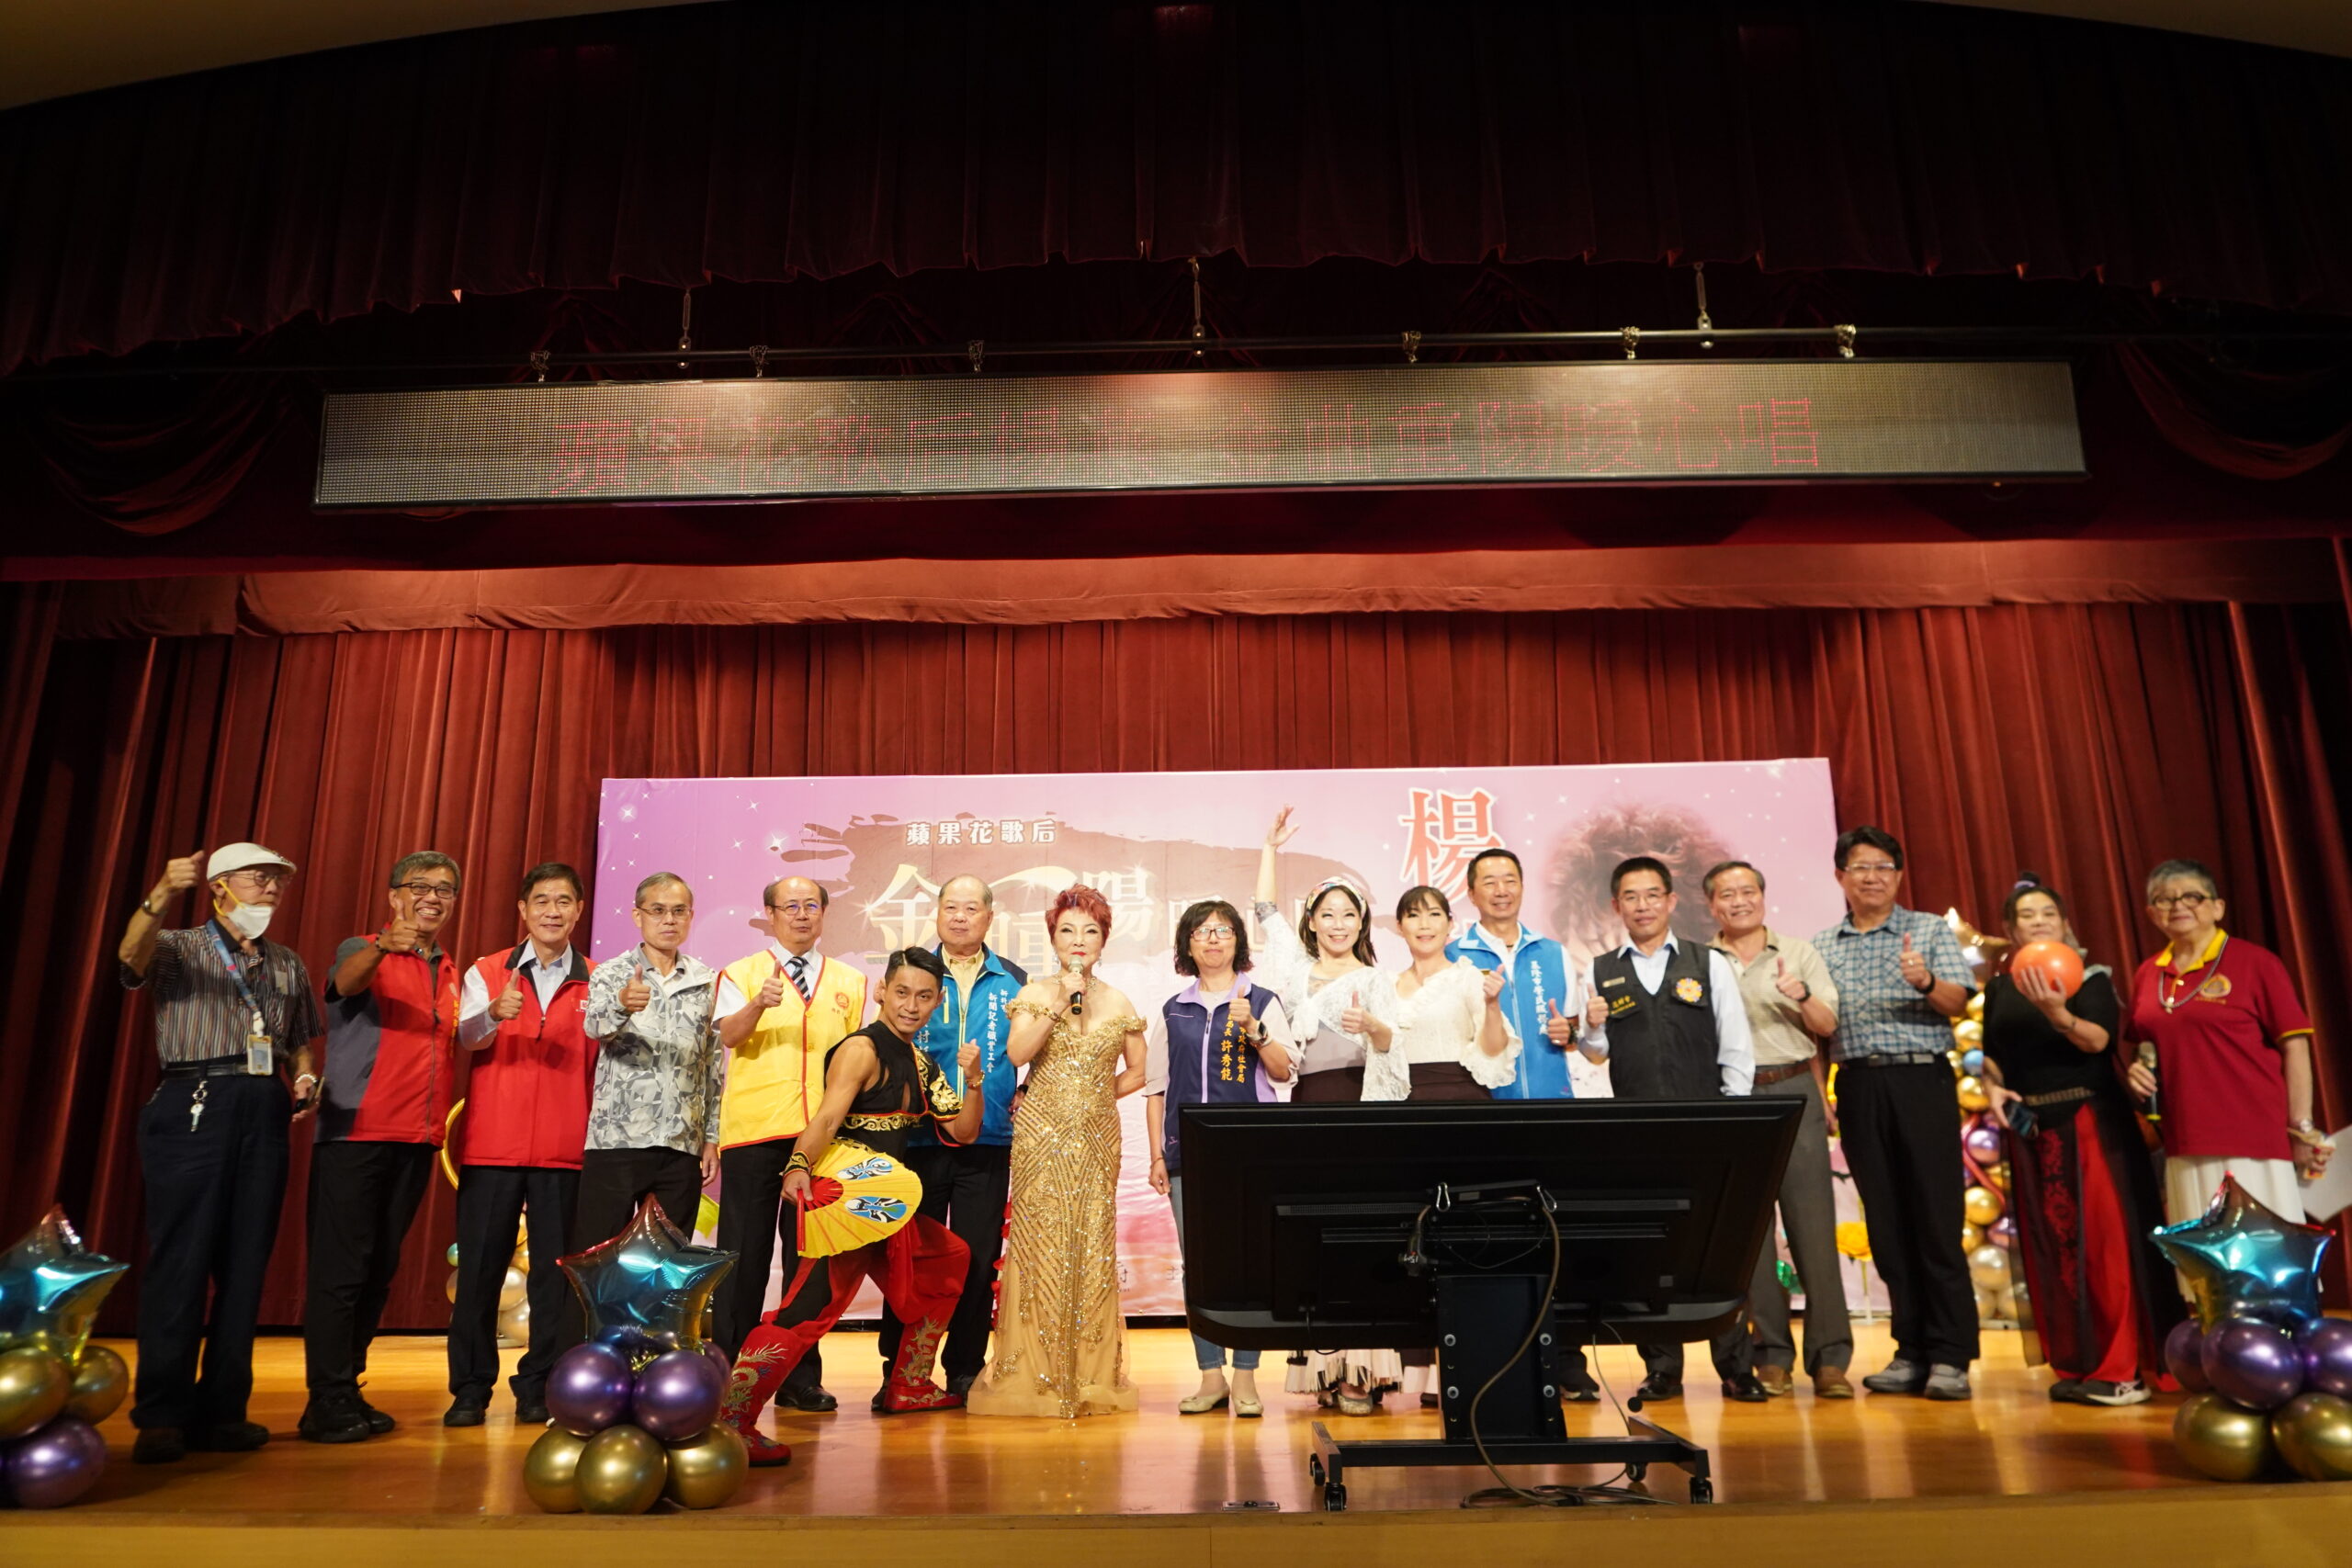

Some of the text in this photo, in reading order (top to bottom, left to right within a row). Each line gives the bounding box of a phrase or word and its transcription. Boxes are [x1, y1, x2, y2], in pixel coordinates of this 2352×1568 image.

[906, 818, 1057, 846] 蘋果花歌后
[1221, 1040, 1233, 1081] 許秀能
